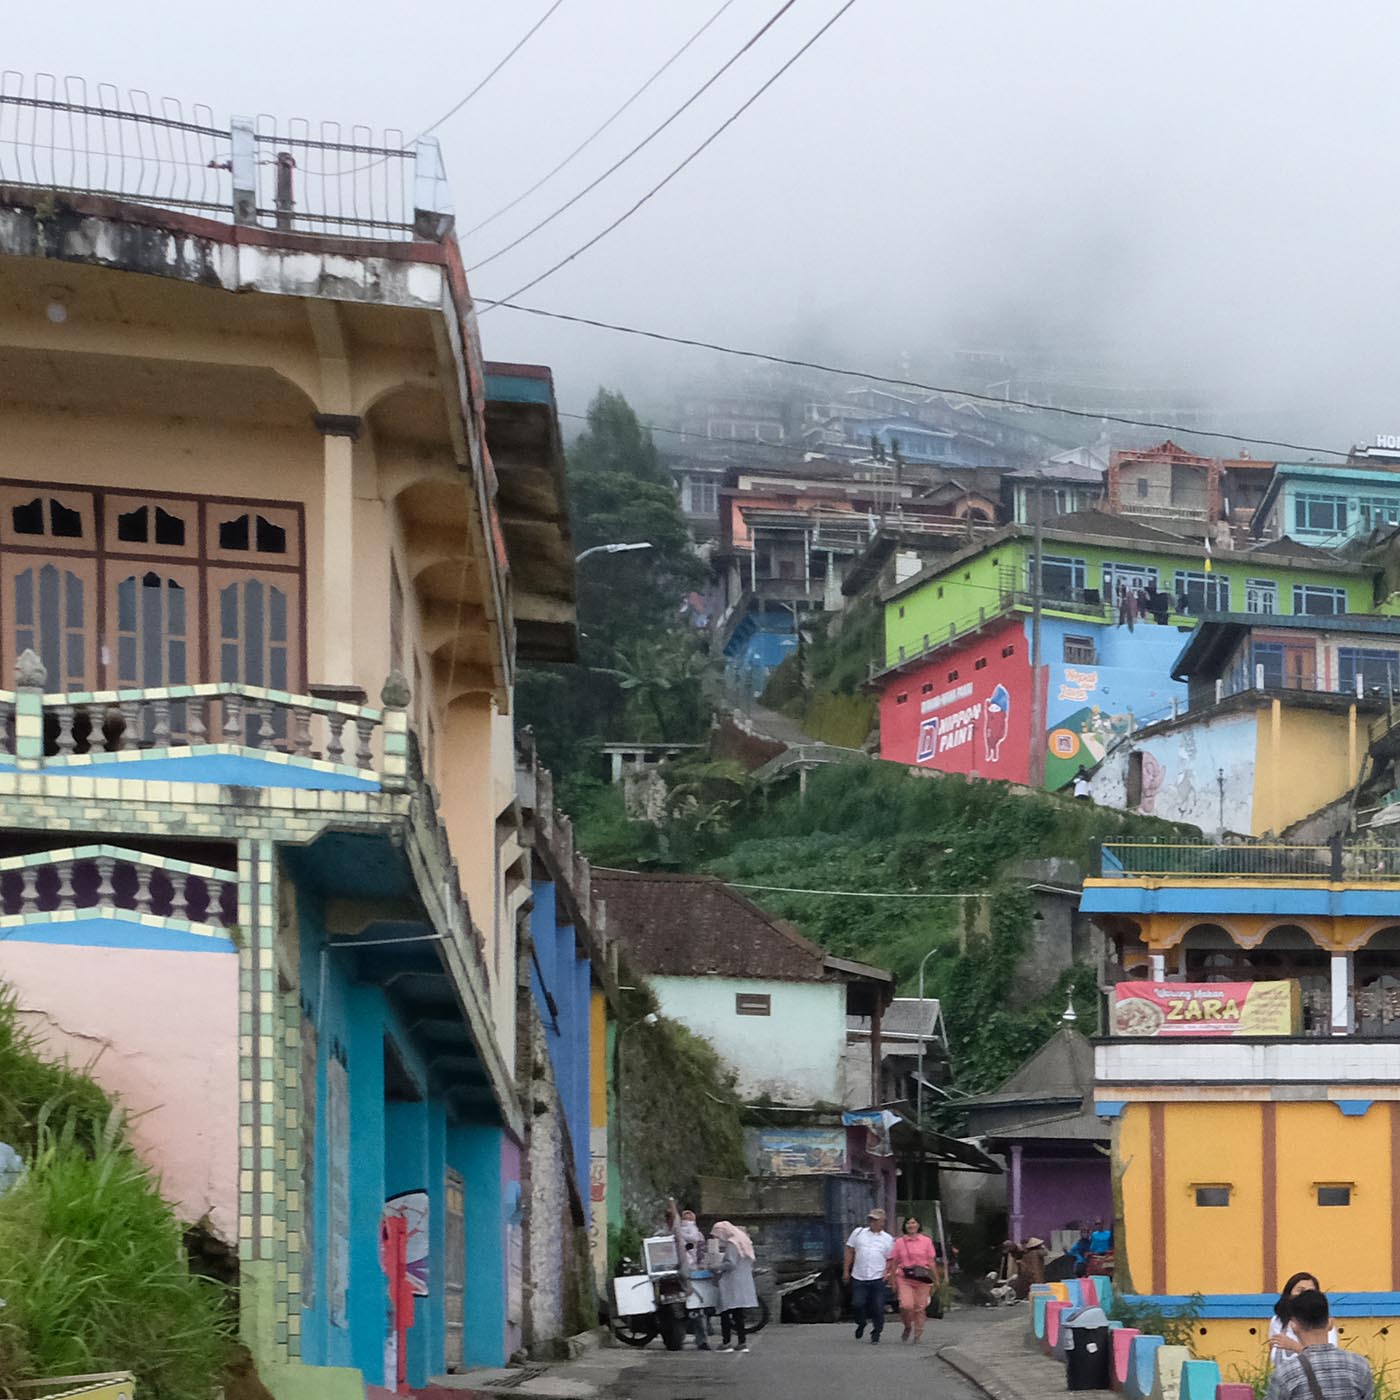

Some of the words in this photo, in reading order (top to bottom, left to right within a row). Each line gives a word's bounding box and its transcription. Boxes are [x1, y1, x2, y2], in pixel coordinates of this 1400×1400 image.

[938, 703, 982, 736] NIPPON
[939, 723, 975, 753] PAINT
[1167, 999, 1240, 1020] ZARA
